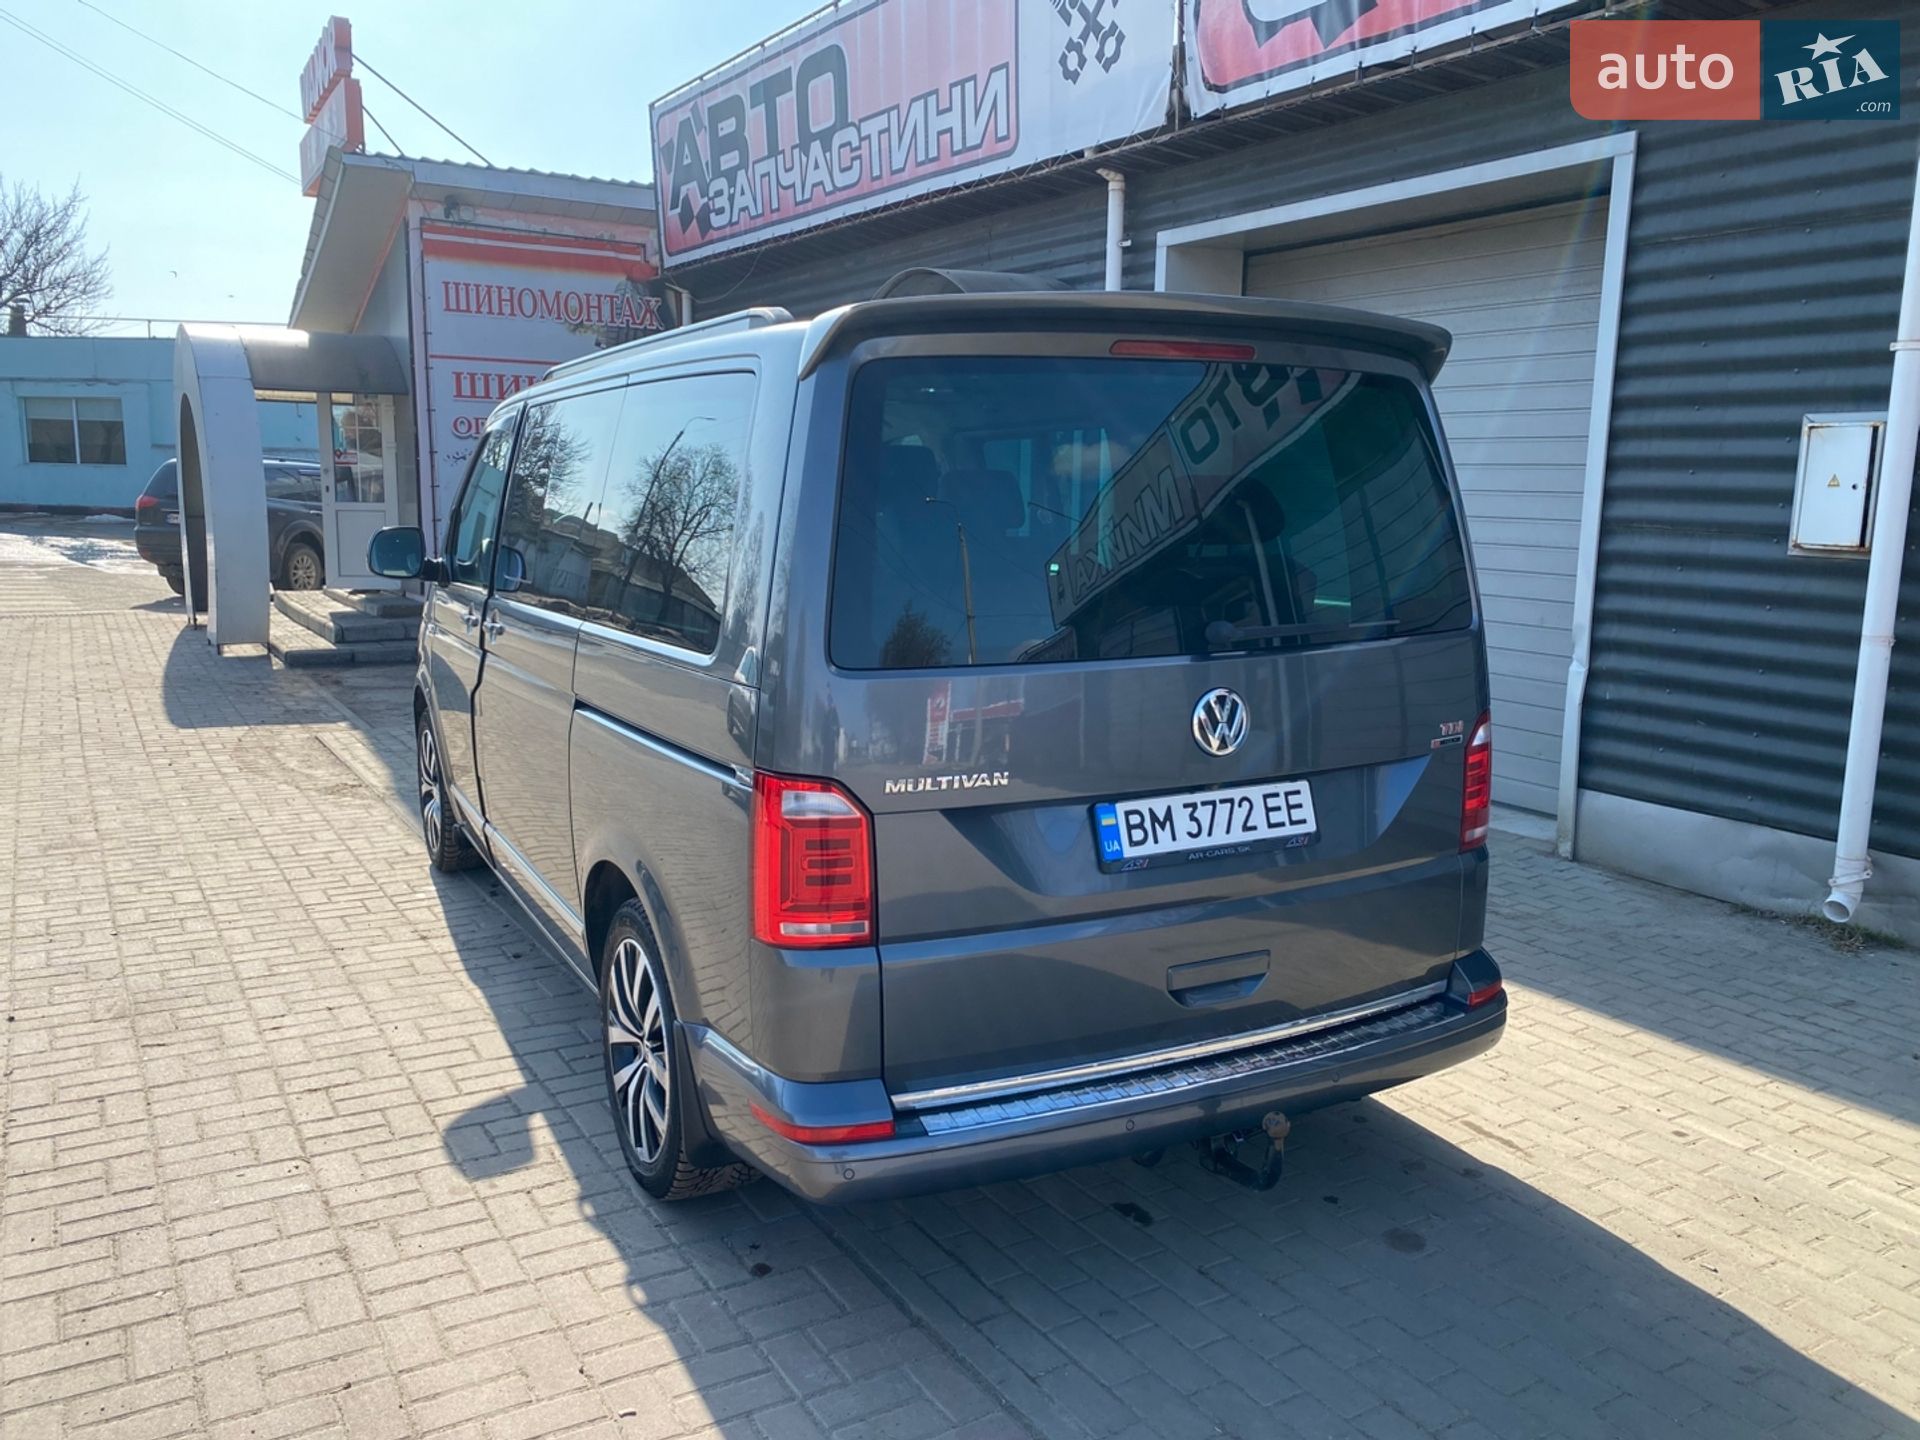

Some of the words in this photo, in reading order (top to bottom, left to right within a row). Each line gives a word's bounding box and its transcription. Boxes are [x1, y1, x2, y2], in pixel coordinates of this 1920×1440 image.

[668, 44, 849, 211] АВТО
[707, 62, 1010, 229] ЗАПЧАСТИНИ
[442, 281, 664, 329] ШИНОМОНТАЖ
[884, 771, 1009, 794] MULTIVAN
[1124, 805, 1177, 848] BM
[1183, 796, 1257, 839] 3772
[1262, 789, 1307, 829] EE
[1105, 841, 1121, 852] UA
